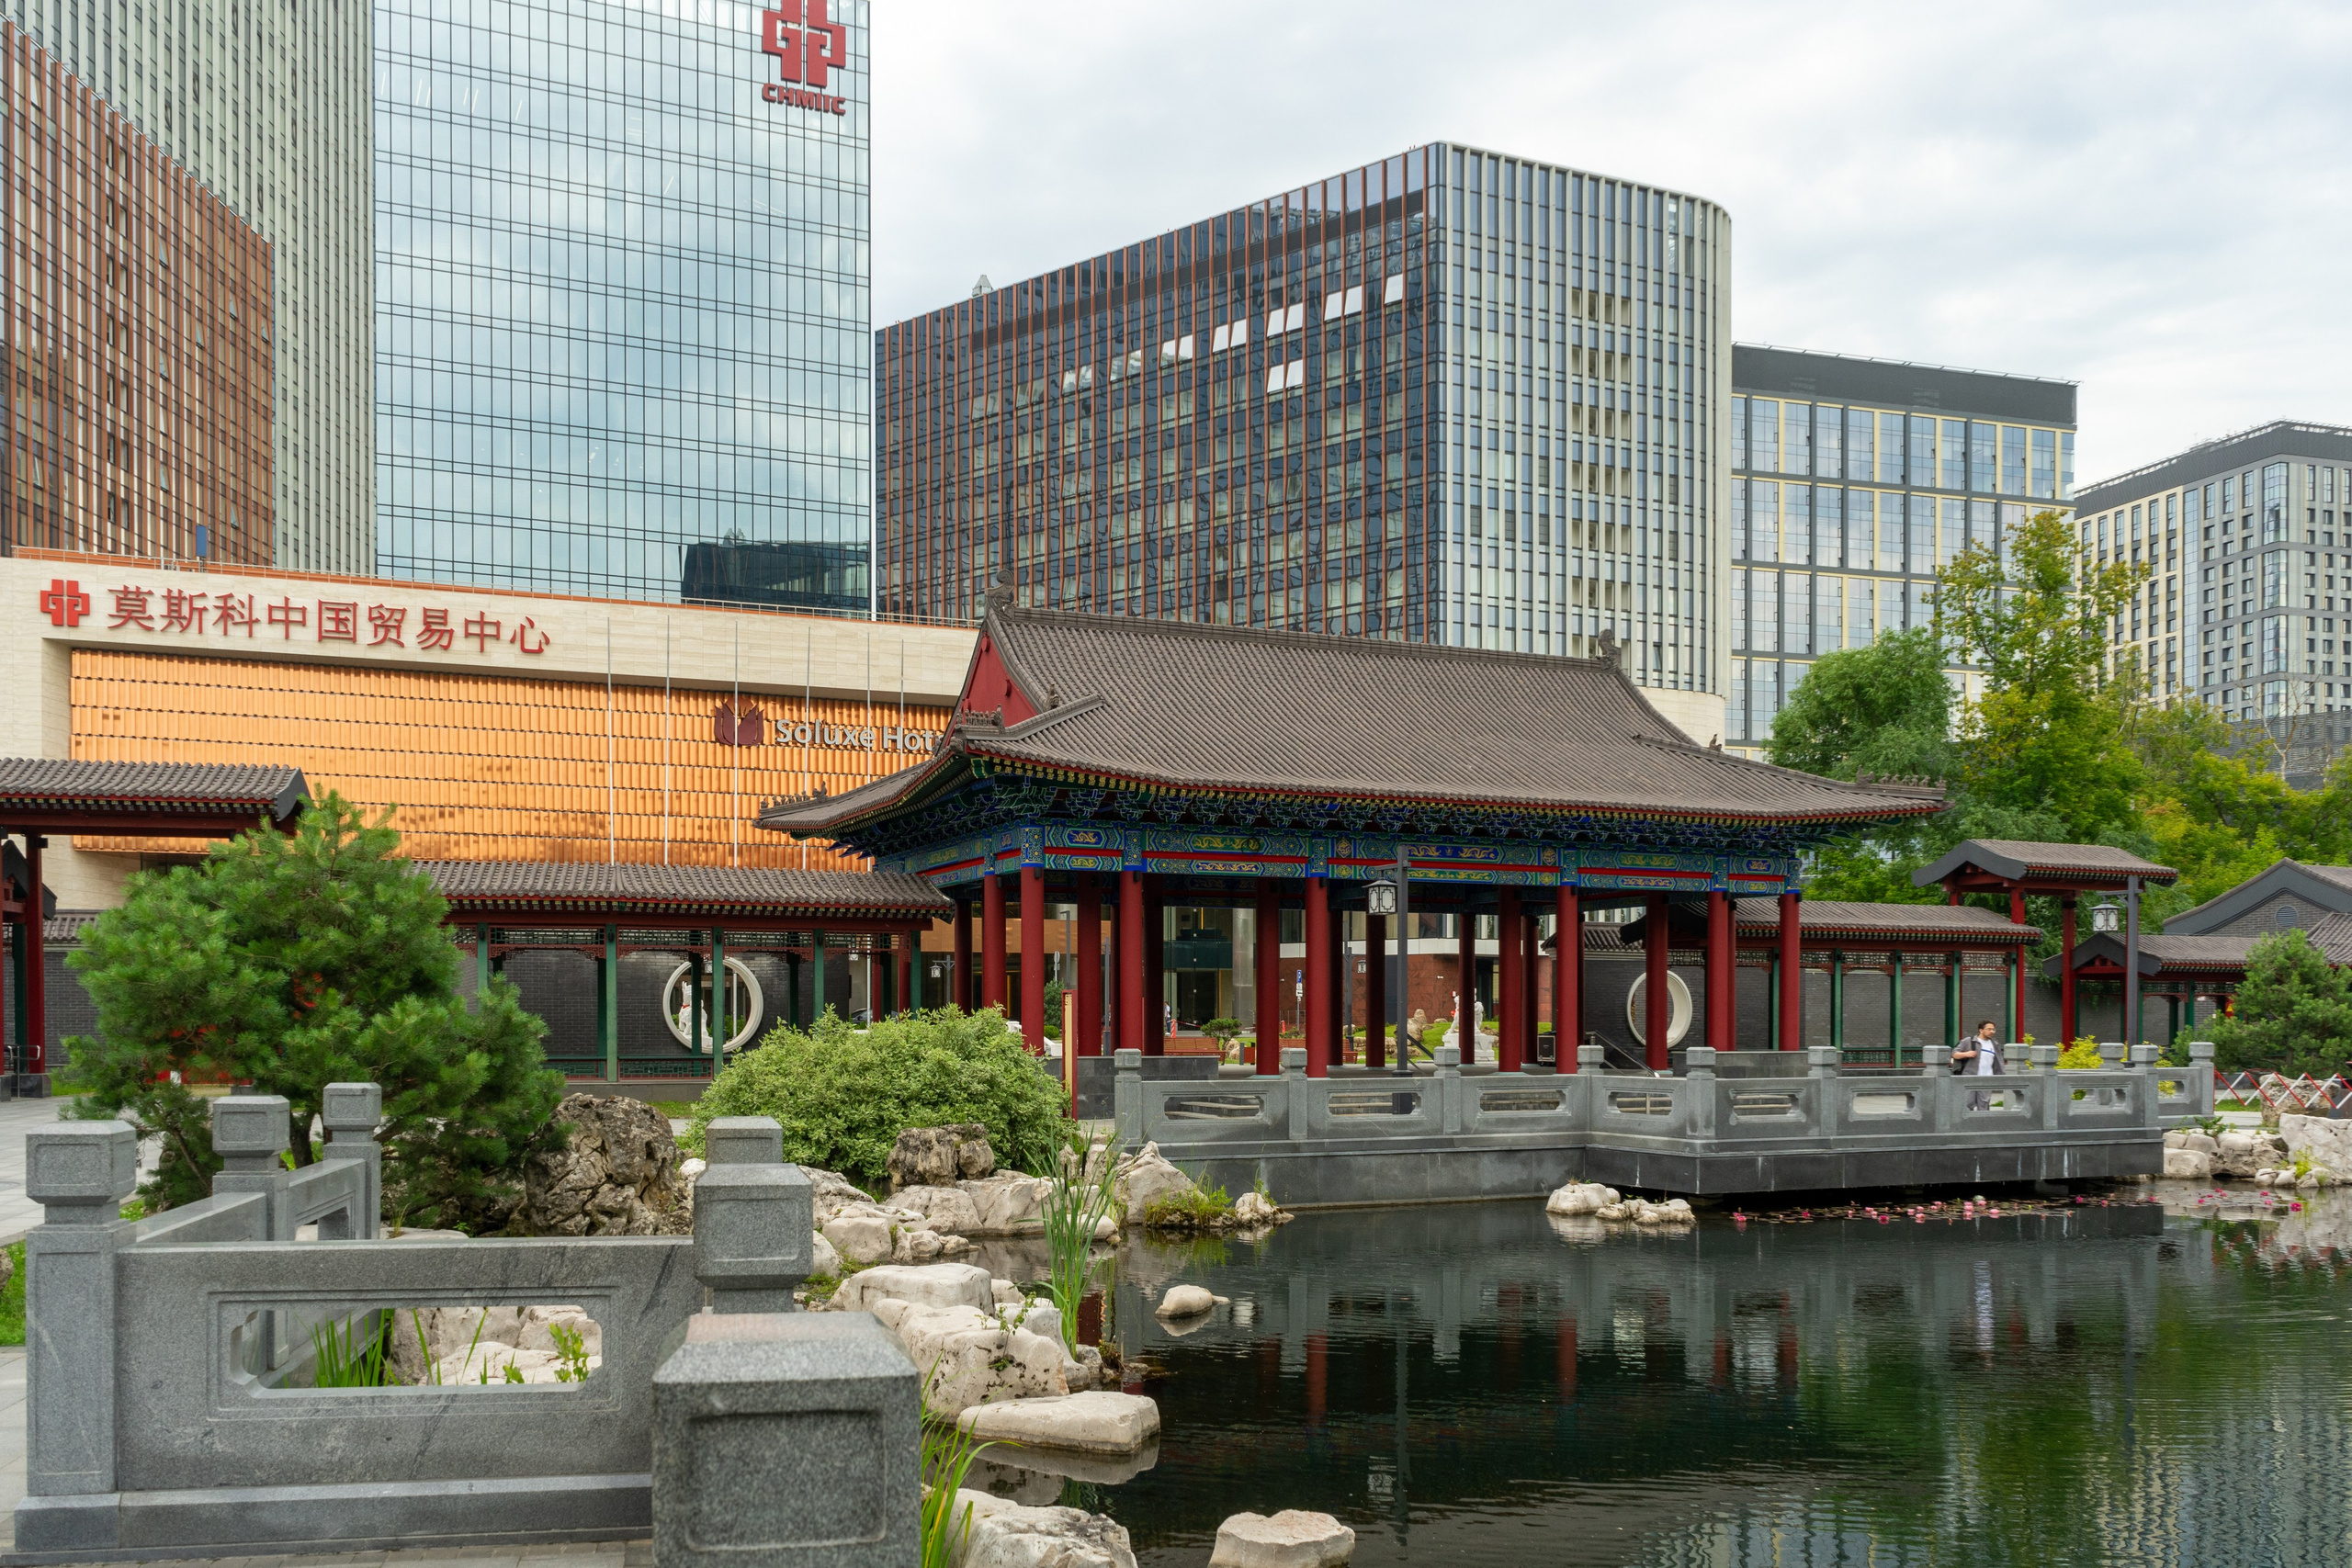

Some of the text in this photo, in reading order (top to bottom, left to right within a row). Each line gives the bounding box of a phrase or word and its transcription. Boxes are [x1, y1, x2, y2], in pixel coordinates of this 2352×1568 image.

[762, 83, 846, 116] CHMIIC
[107, 584, 550, 654] 莫斯科中国贸易中心
[776, 718, 943, 751] Soluxe Hot
